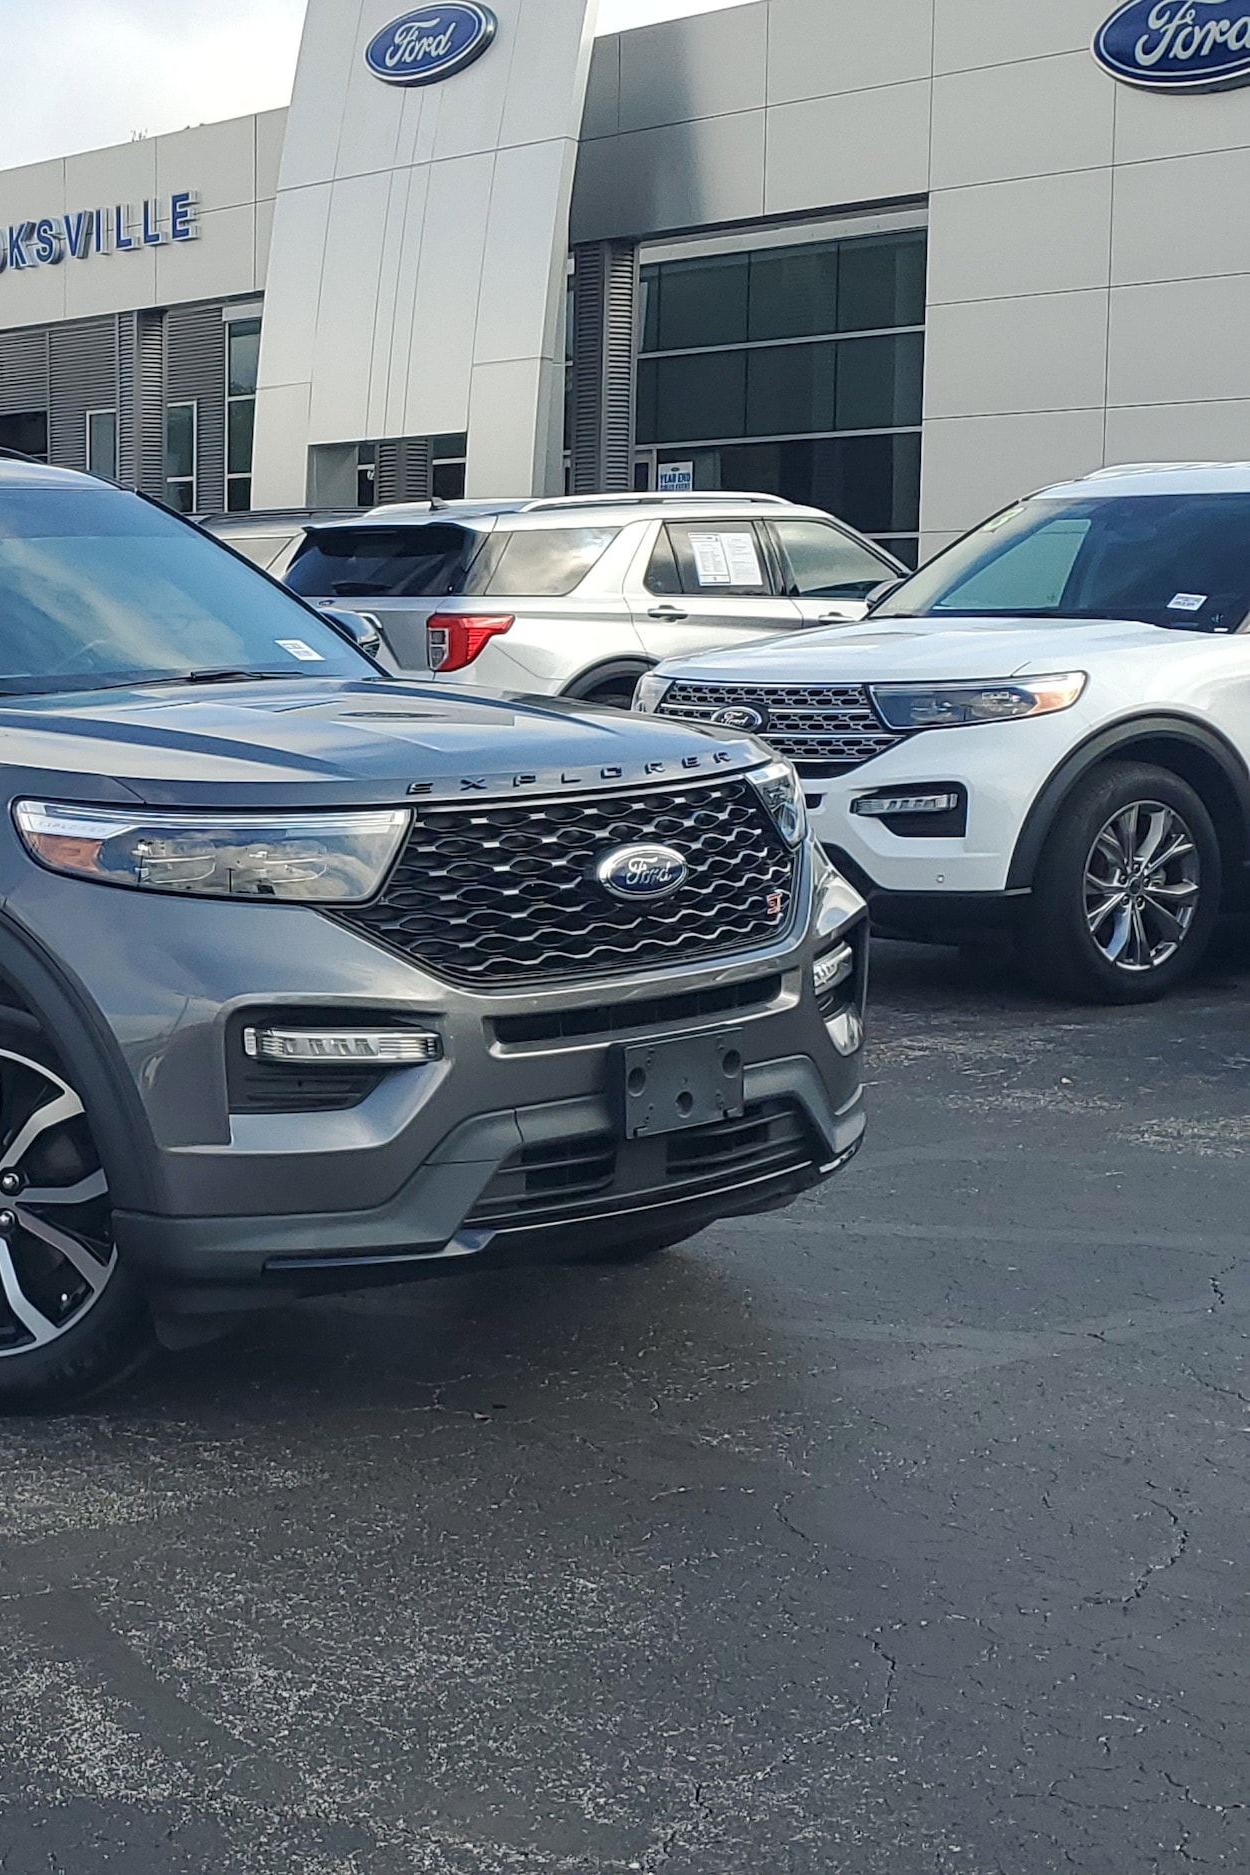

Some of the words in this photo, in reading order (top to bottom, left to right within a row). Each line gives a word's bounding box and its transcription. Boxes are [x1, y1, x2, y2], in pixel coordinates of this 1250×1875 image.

[385, 17, 456, 67] Ford
[406, 751, 732, 796] EXPLORER
[625, 856, 672, 885] Ford
